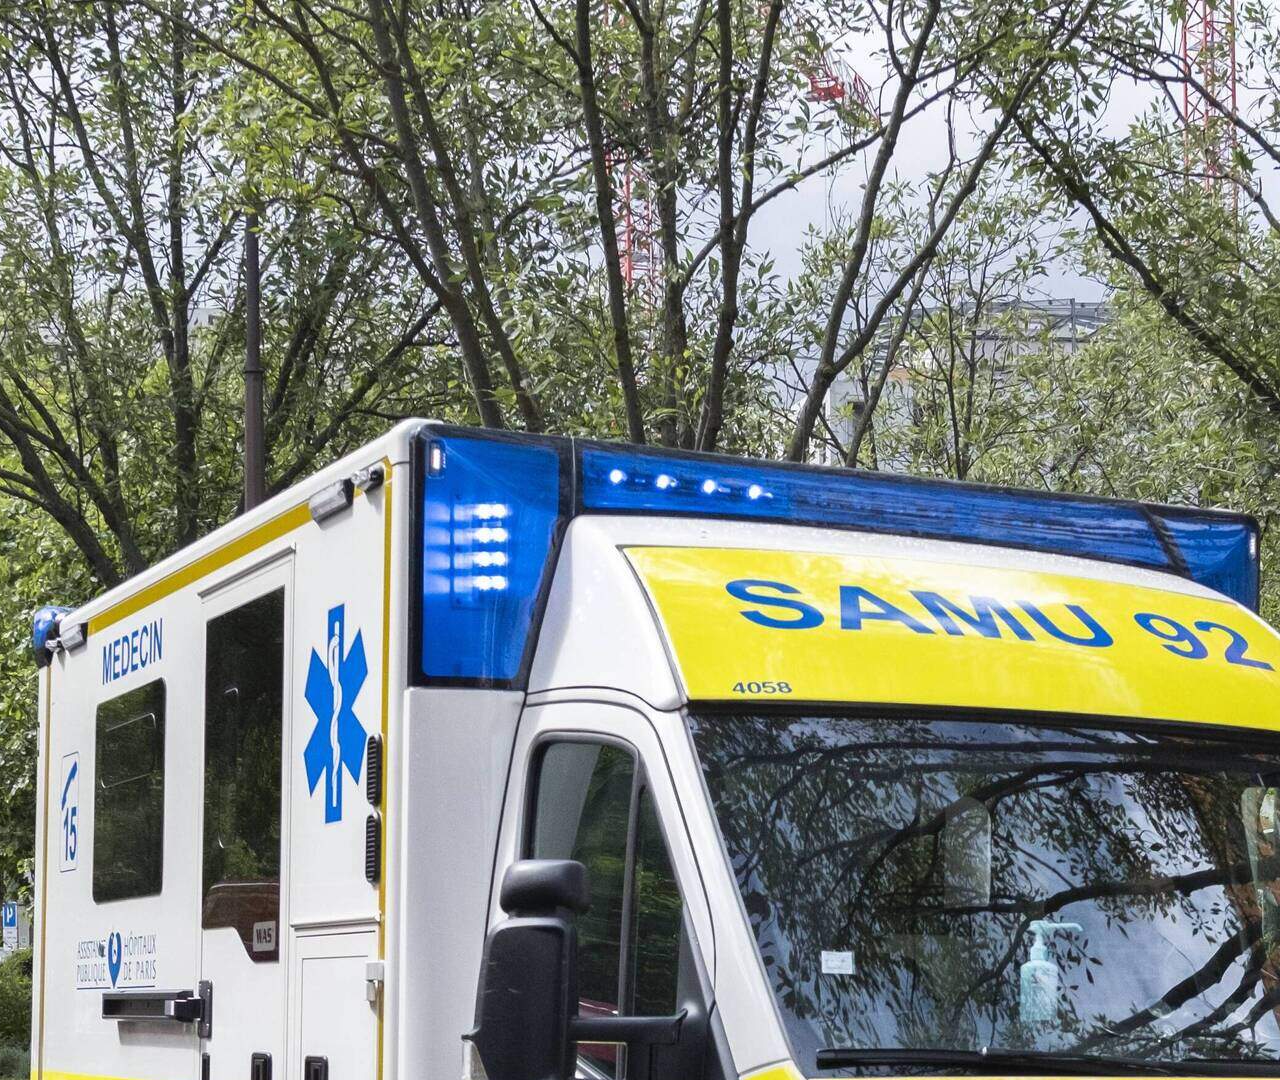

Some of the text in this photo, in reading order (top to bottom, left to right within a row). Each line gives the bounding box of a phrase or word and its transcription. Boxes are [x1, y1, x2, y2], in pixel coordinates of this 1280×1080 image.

[725, 578, 1275, 672] SAMU 92
[102, 617, 163, 686] MEDECIN
[732, 680, 792, 695] 4058
[63, 806, 77, 861] 15
[124, 931, 157, 956] HÔPITAUX
[256, 928, 272, 944] WAS
[77, 959, 157, 985] PUBLIQUE DE PARIS
